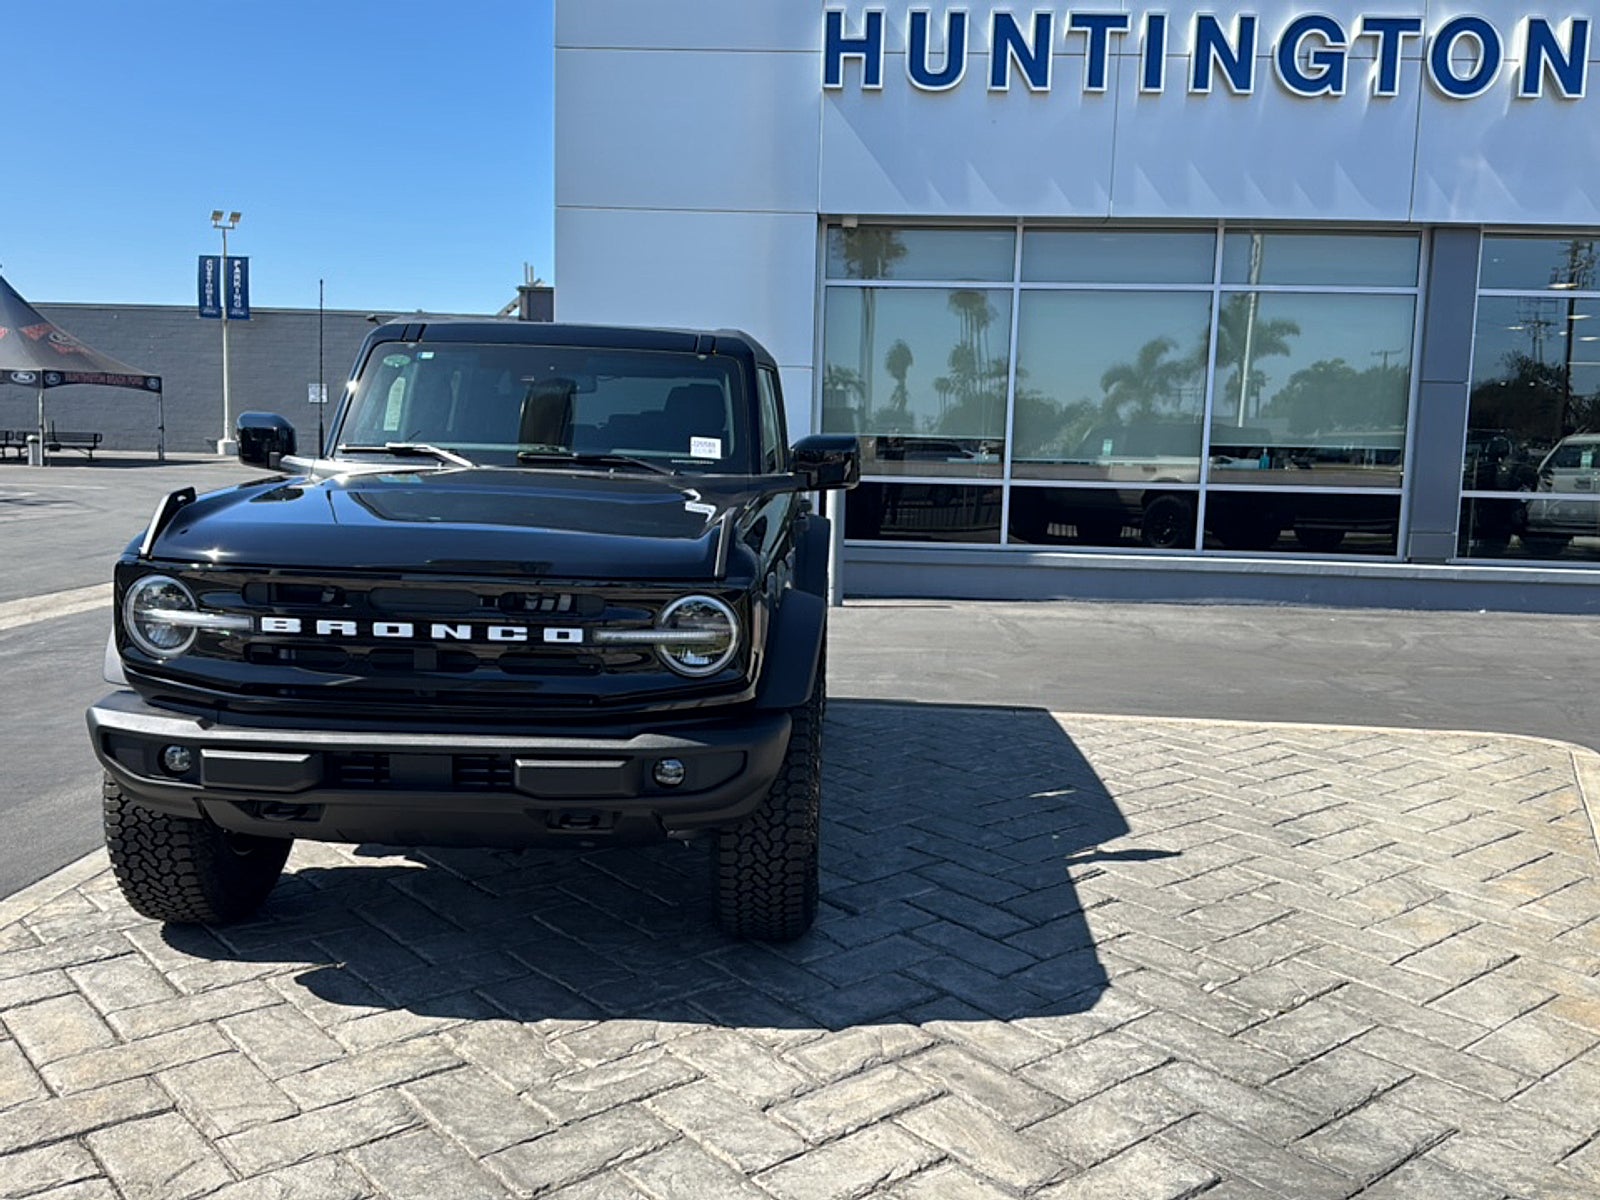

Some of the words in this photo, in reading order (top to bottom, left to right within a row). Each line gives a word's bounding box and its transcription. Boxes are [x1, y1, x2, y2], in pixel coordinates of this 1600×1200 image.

[823, 6, 1589, 99] HUNTINGTON
[233, 260, 242, 308] PARKING
[260, 616, 584, 643] BRONCO
